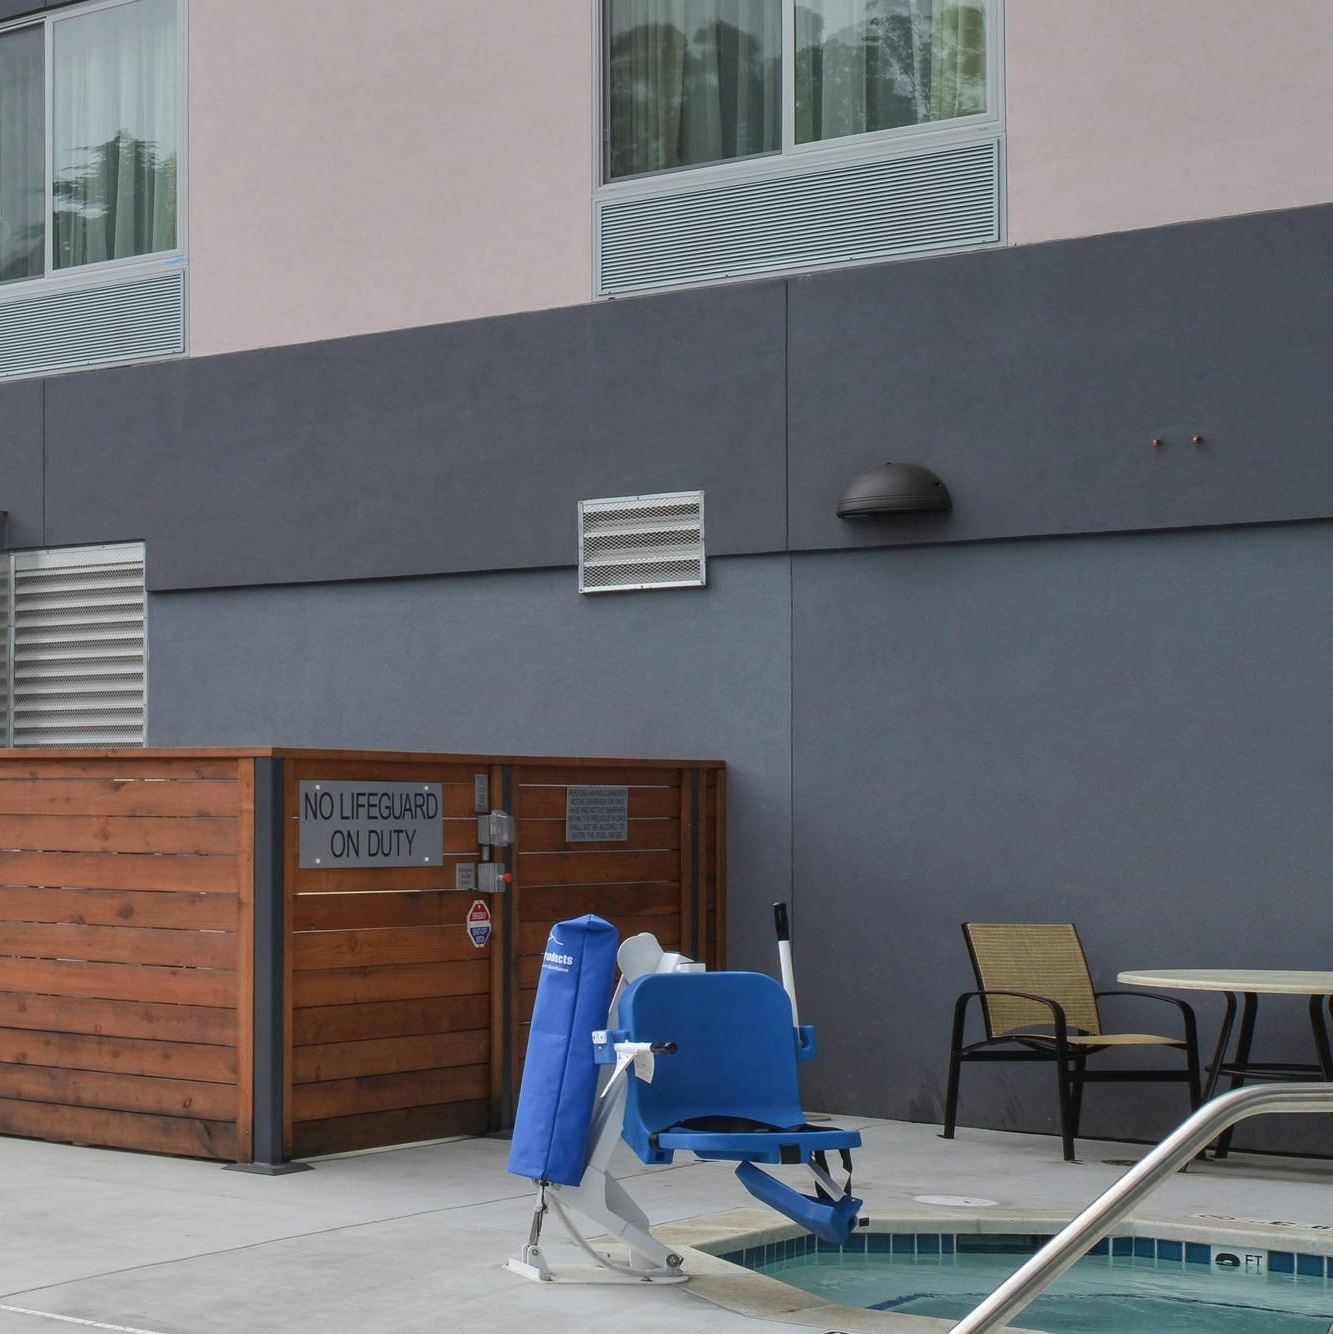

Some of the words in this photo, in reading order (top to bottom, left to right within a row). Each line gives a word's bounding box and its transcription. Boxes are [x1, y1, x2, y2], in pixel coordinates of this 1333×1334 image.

[304, 791, 333, 820] NO
[339, 791, 438, 820] LIFEGUARD
[330, 829, 361, 857] ON
[367, 829, 417, 857] DUTY
[1244, 1254, 1263, 1267] FT
